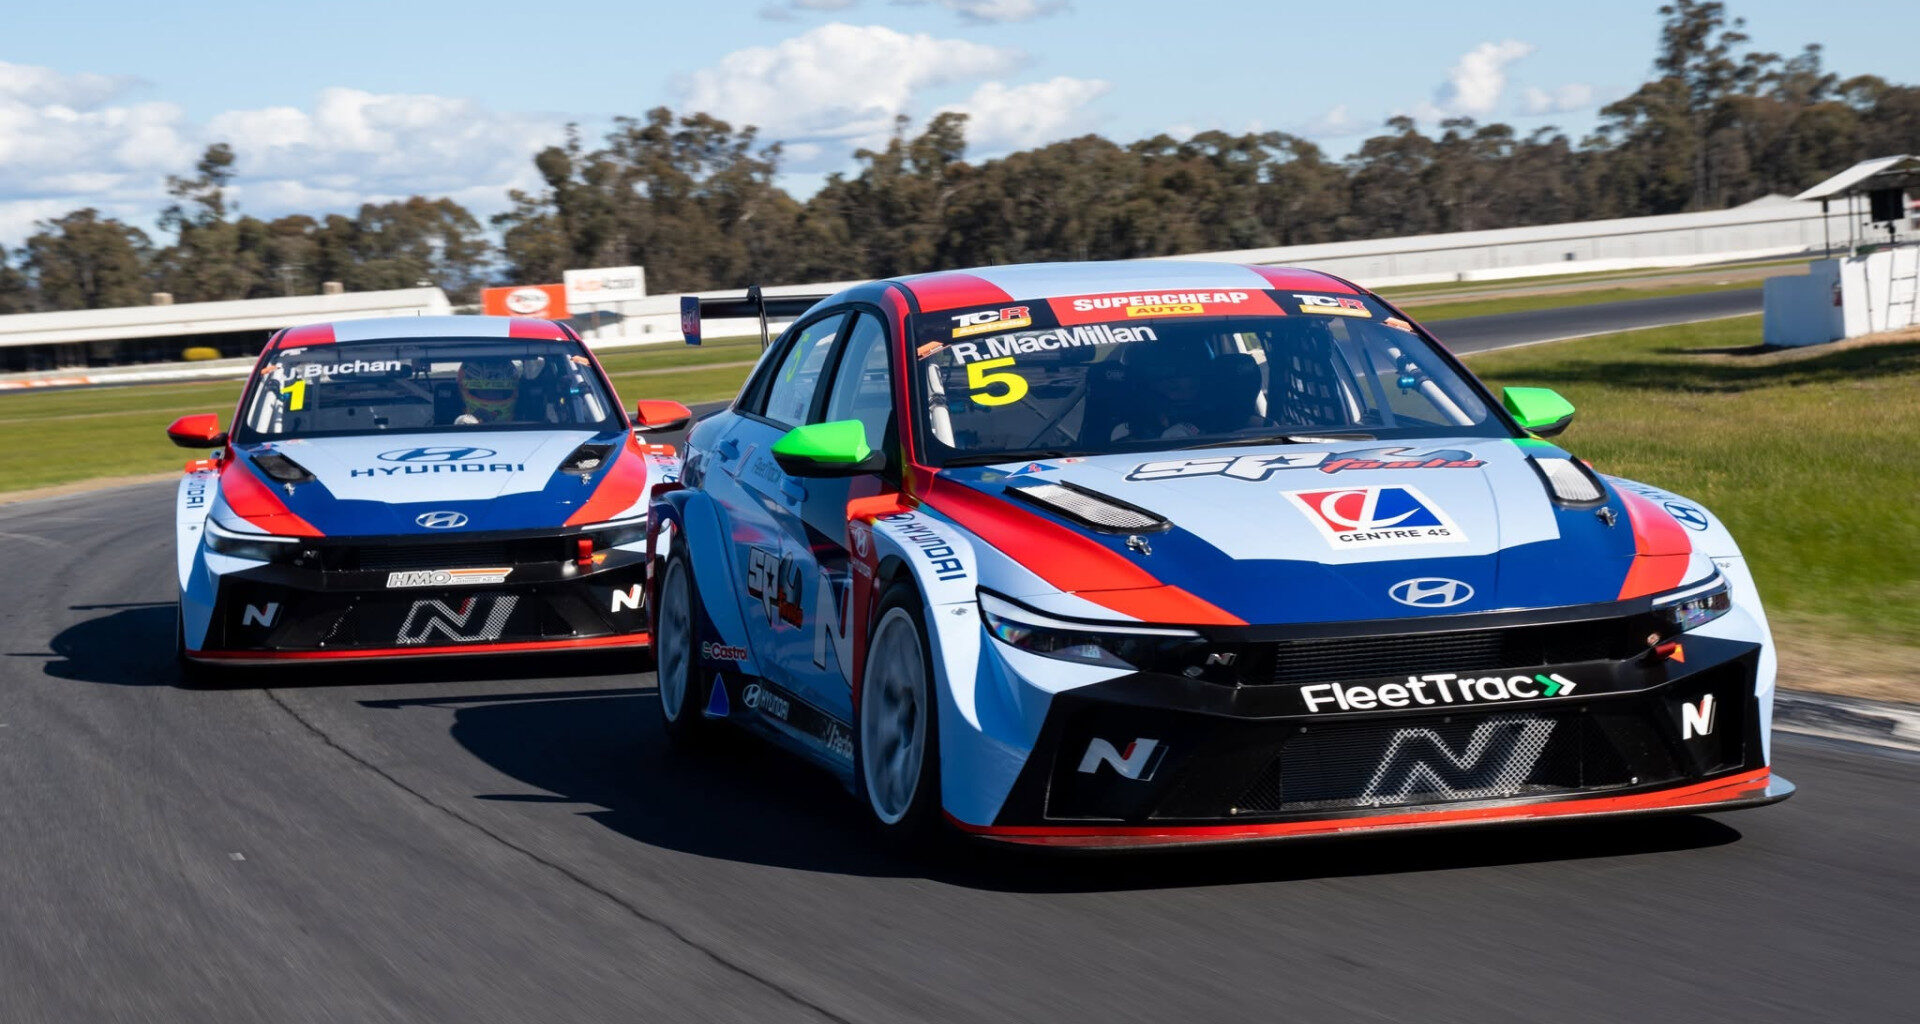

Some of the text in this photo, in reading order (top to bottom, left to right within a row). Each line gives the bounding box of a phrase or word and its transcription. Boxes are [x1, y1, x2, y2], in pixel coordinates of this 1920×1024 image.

[1073, 291, 1249, 312] SUPERCHEAP
[1136, 305, 1195, 314] AUTO
[1293, 294, 1366, 310] TCR
[952, 306, 1031, 328] TCR
[951, 325, 1158, 365] R.MacMillan
[283, 359, 401, 381] J.Buchan
[966, 356, 1029, 407] 5
[280, 380, 306, 412] 1
[351, 463, 524, 478] HYUNDAI
[1339, 528, 1451, 542] CENTRE 45
[895, 522, 968, 581] HYUNDAI
[387, 570, 452, 587] HMO
[242, 602, 283, 628] N
[1300, 674, 1539, 713] FleetTrac
[1682, 693, 1716, 740] N
[1077, 737, 1168, 781] N
